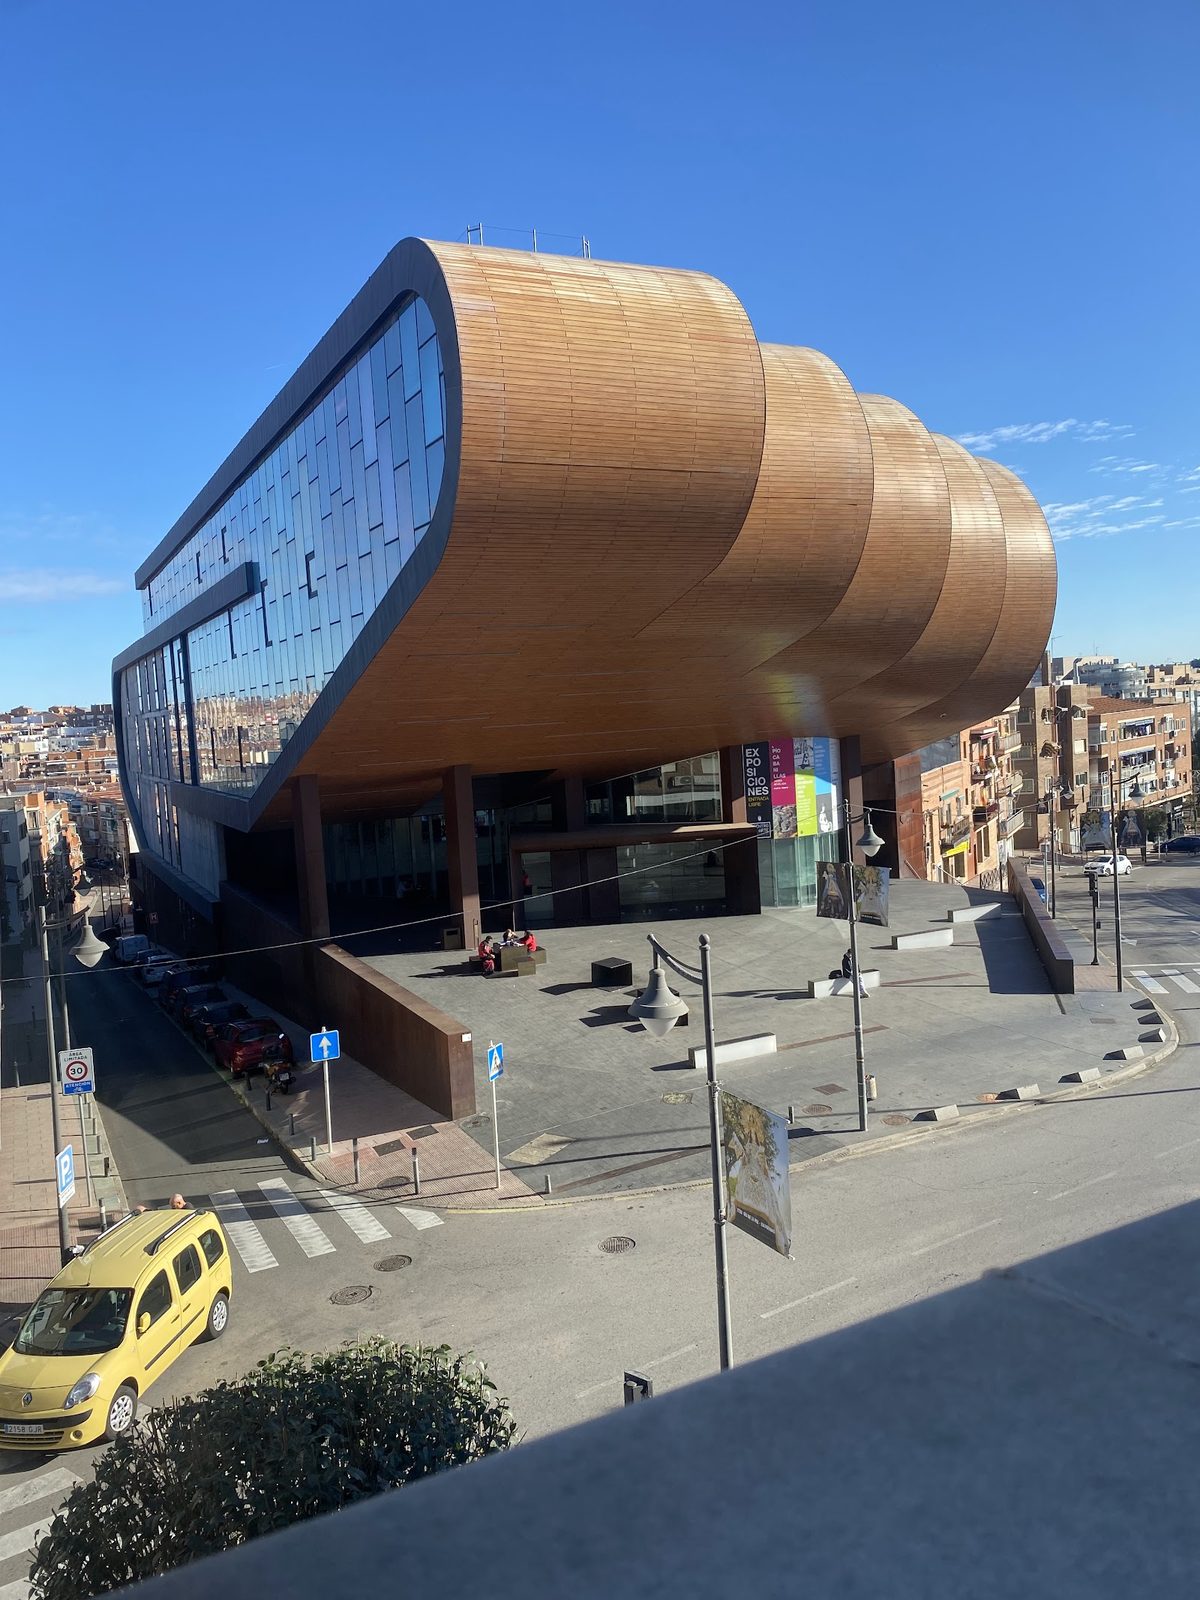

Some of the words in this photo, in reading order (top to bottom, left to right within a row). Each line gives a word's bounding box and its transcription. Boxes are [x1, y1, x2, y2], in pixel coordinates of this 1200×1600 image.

[745, 748, 760, 758] EX
[746, 757, 761, 768] PO
[746, 767, 757, 777] SI
[747, 776, 766, 787] CIO
[747, 786, 769, 797] NES
[60, 1154, 71, 1187] P
